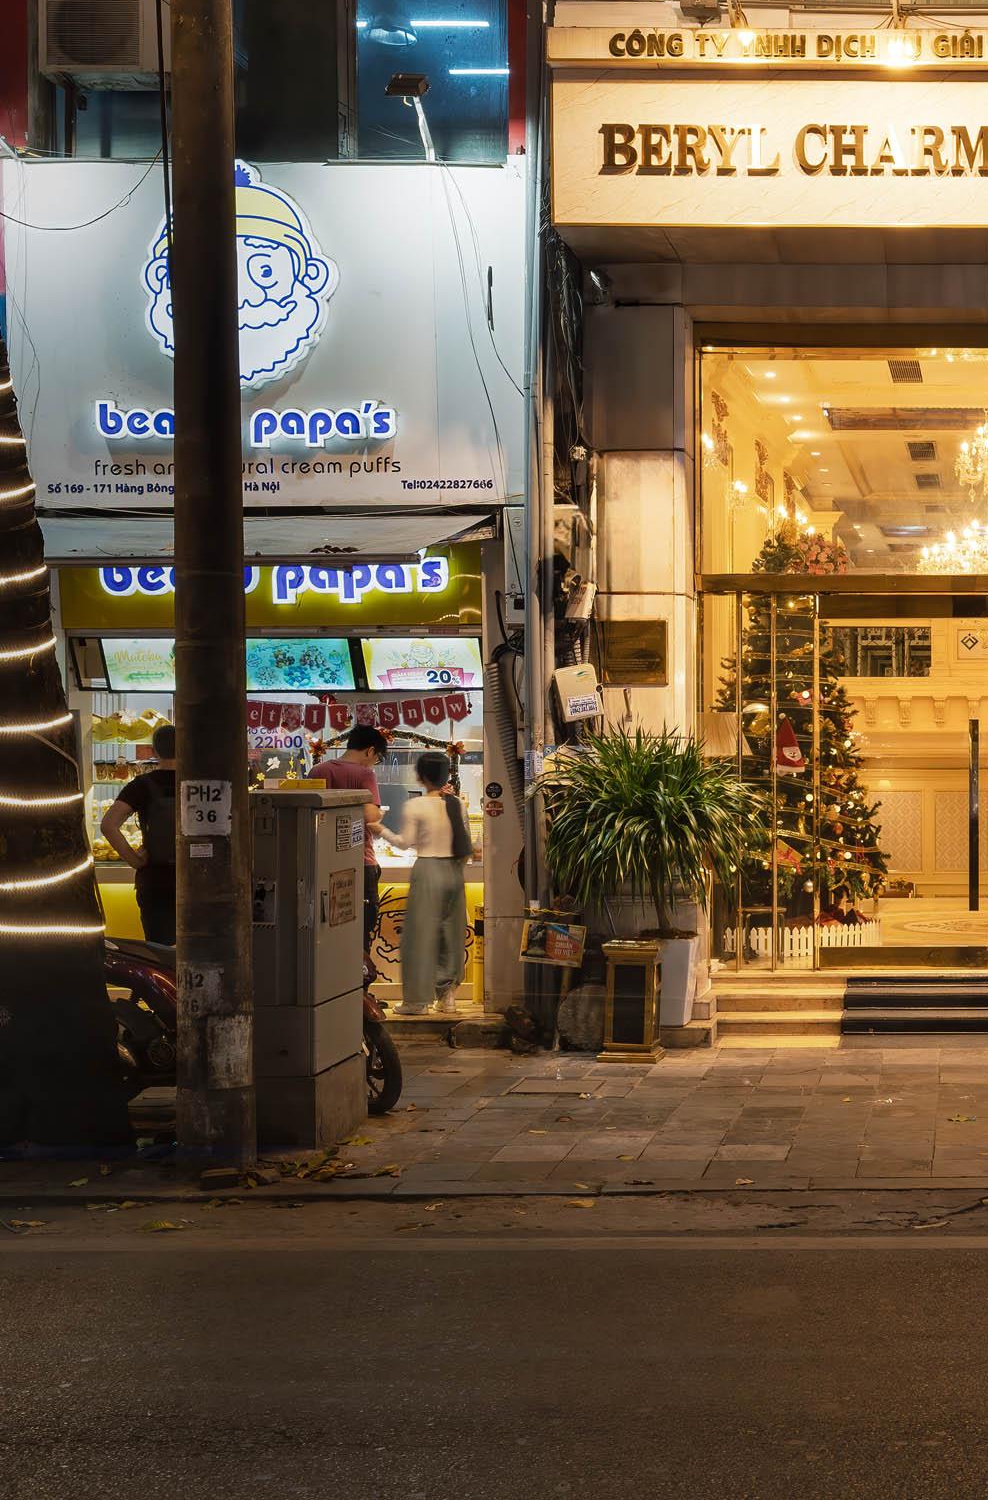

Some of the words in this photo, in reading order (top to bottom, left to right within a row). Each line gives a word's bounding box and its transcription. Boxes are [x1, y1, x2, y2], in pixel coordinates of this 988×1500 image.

[608, 29, 684, 58] CÔNG
[695, 33, 730, 57] TY
[816, 34, 876, 62] DỊCH
[598, 123, 781, 176] BERYL
[97, 402, 174, 436] bea
[252, 402, 393, 444] papa's
[94, 459, 146, 476] fresh
[281, 461, 343, 475] cream
[349, 457, 401, 478] puffs
[47, 482, 62, 493] Số
[64, 484, 84, 493] 169
[94, 483, 112, 493] 171
[115, 483, 144, 495] Hàng
[147, 483, 174, 495] Bông
[244, 481, 260, 492] Hà
[262, 481, 280, 493] Nội
[383, 701, 463, 723] Snow
[254, 735, 303, 749] 22h00
[187, 785, 222, 803] PH2
[195, 809, 217, 823] 36
